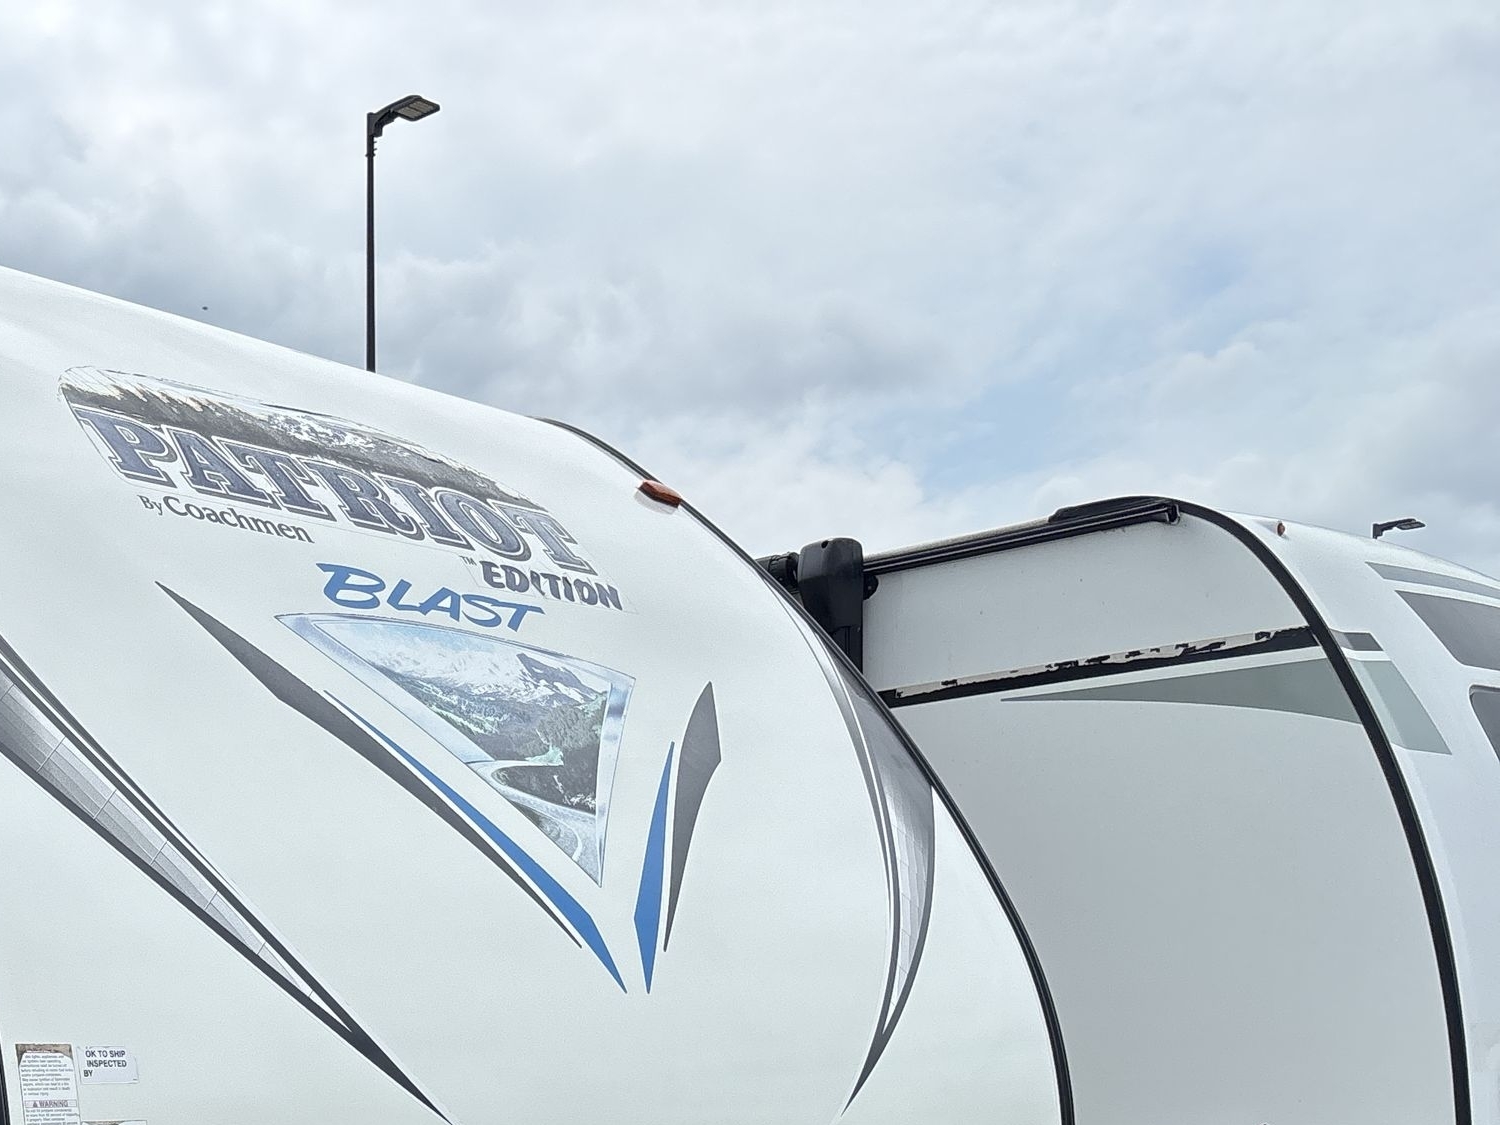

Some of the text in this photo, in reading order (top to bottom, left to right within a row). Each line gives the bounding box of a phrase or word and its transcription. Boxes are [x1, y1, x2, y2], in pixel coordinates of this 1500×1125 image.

[79, 404, 597, 575] PATRIOT
[137, 494, 315, 544] By Coachmen
[316, 562, 545, 633] BLAST
[85, 1050, 126, 1058] OK TO SHIP
[87, 1059, 127, 1068] INSPECTED
[83, 1069, 93, 1077] BY
[39, 1100, 69, 1108] WARNING
